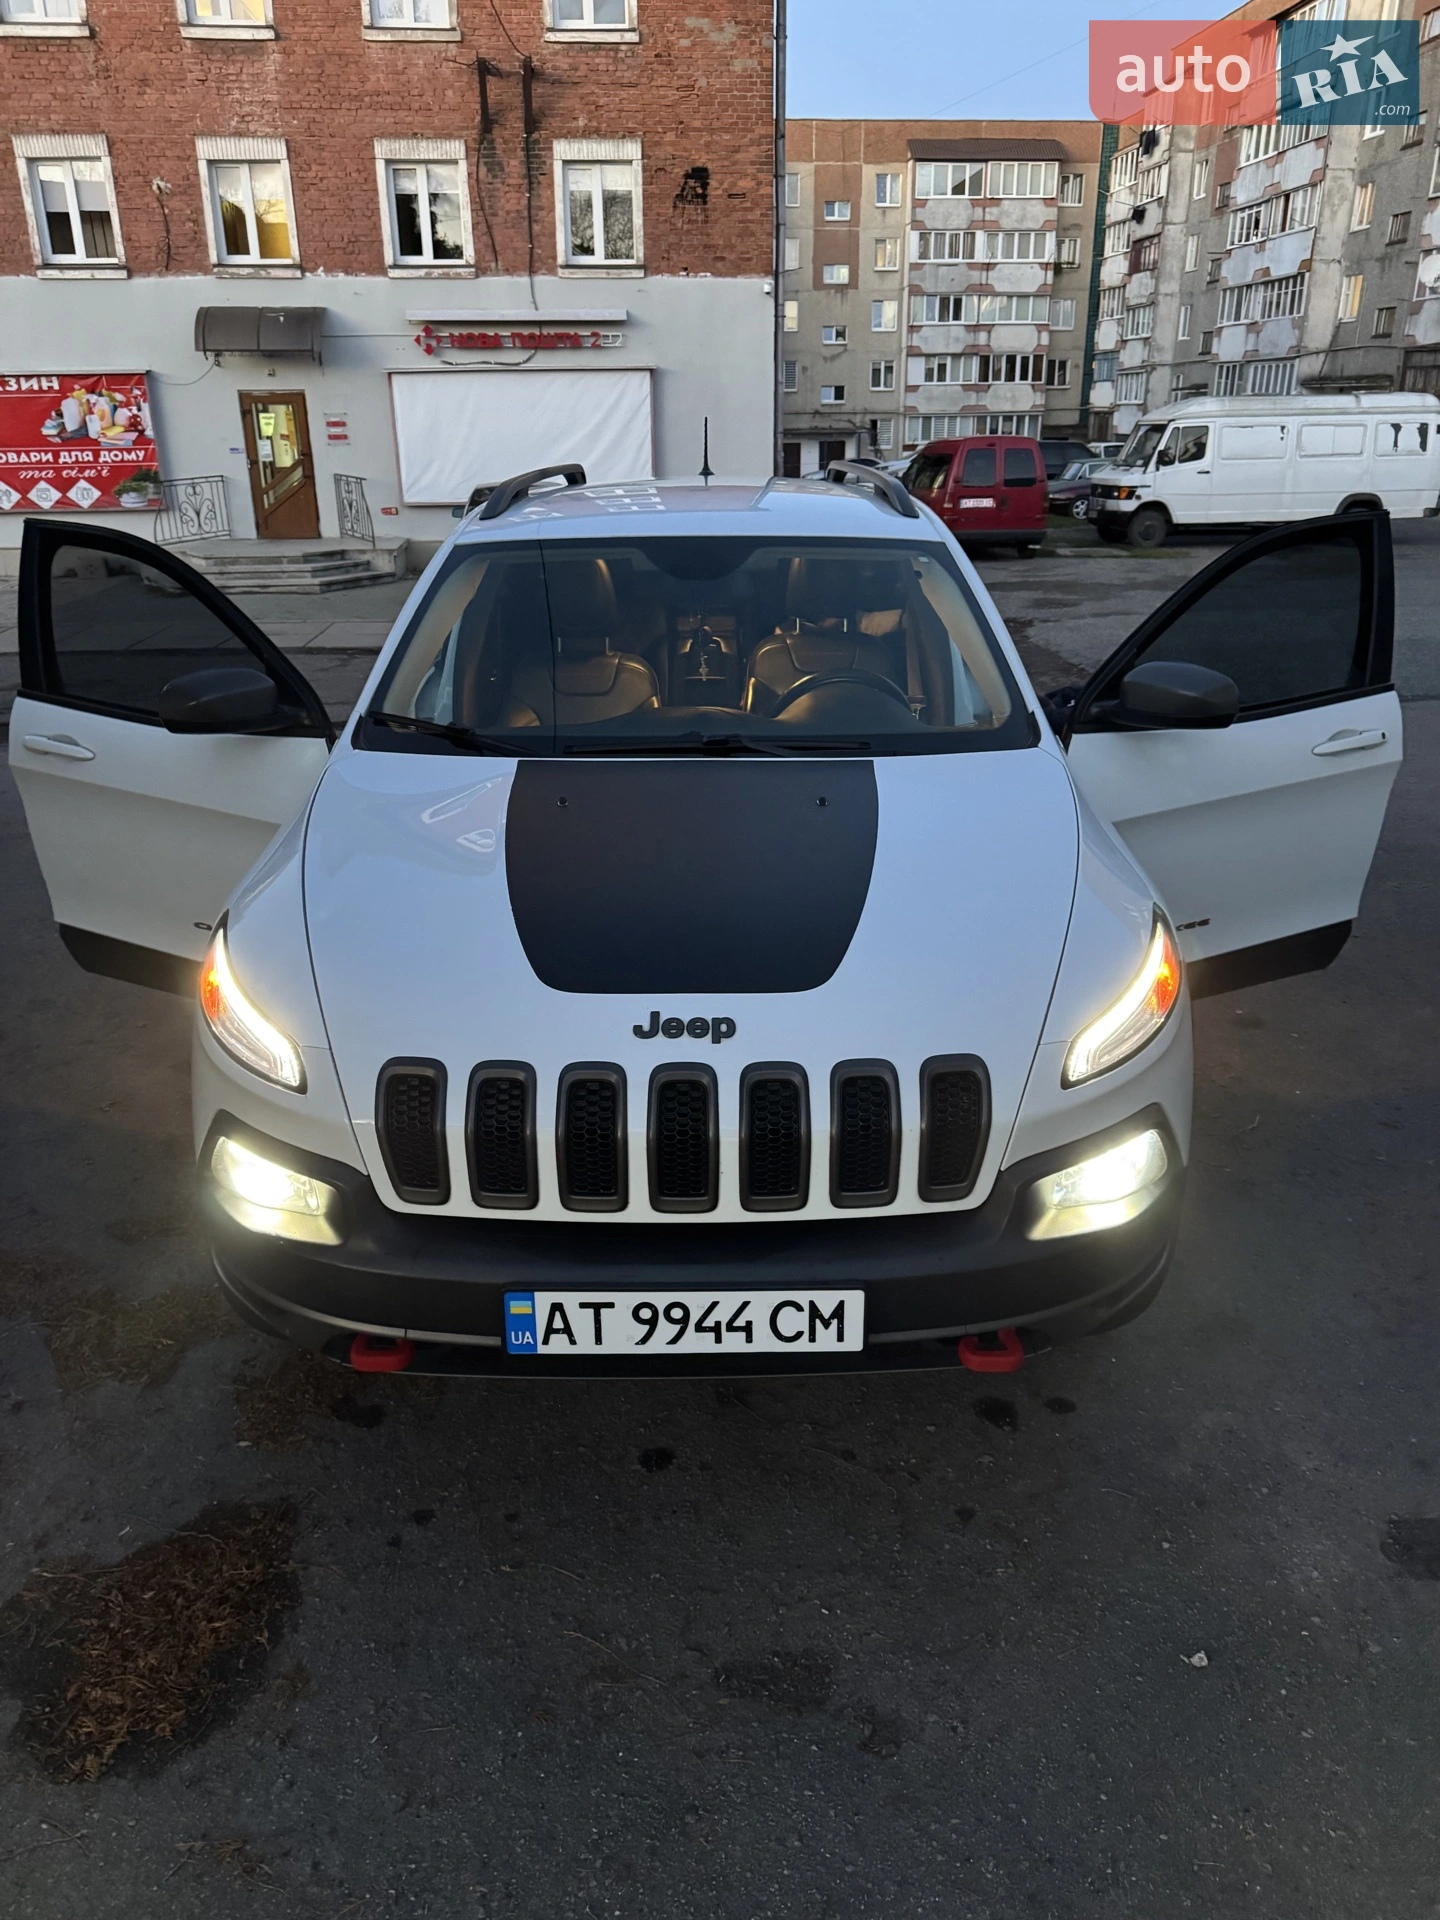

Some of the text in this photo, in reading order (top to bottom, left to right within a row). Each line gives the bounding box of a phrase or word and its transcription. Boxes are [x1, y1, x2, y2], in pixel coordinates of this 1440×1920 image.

[449, 331, 504, 348] НОВА
[510, 331, 583, 349] ПОШТА
[0, 376, 60, 391] ЗИН
[58, 450, 94, 464] ДЛЯ
[98, 449, 145, 464] ДОМУ
[633, 1011, 737, 1044] Jeep
[511, 1300, 845, 1345] UA AT 9944 CM
